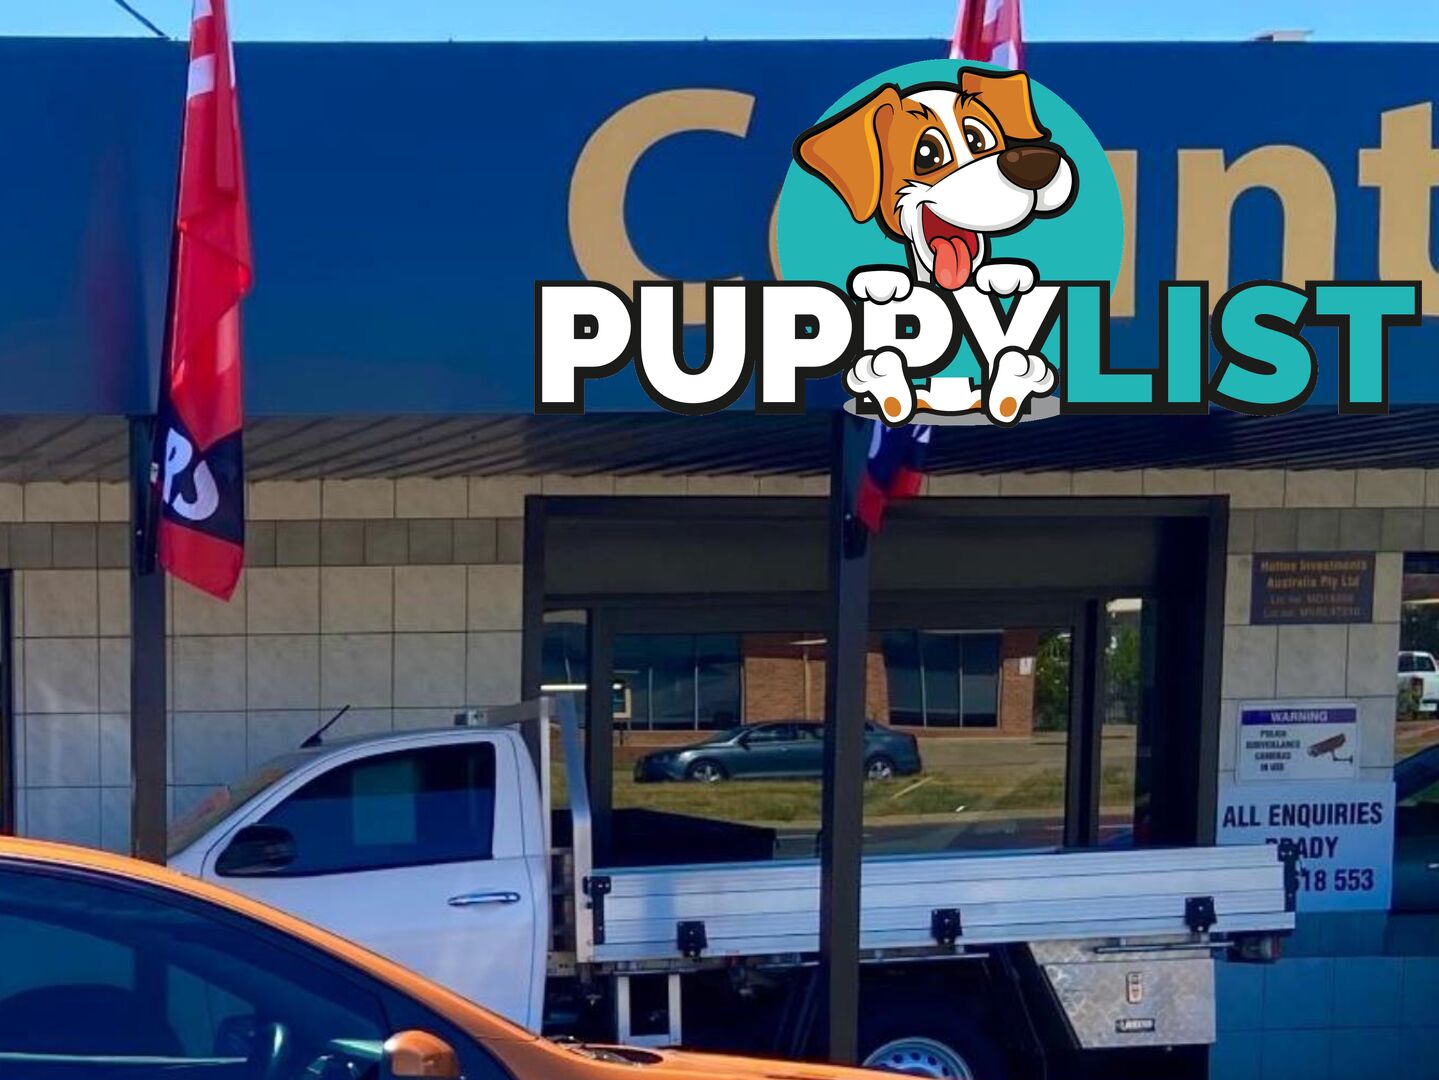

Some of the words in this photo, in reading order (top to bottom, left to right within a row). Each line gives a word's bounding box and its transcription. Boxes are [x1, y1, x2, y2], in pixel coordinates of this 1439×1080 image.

[1271, 711, 1328, 722] WARNING
[1223, 805, 1262, 828] ALL
[1269, 802, 1383, 828] ENQUIRIES
[1334, 868, 1374, 892] 553
